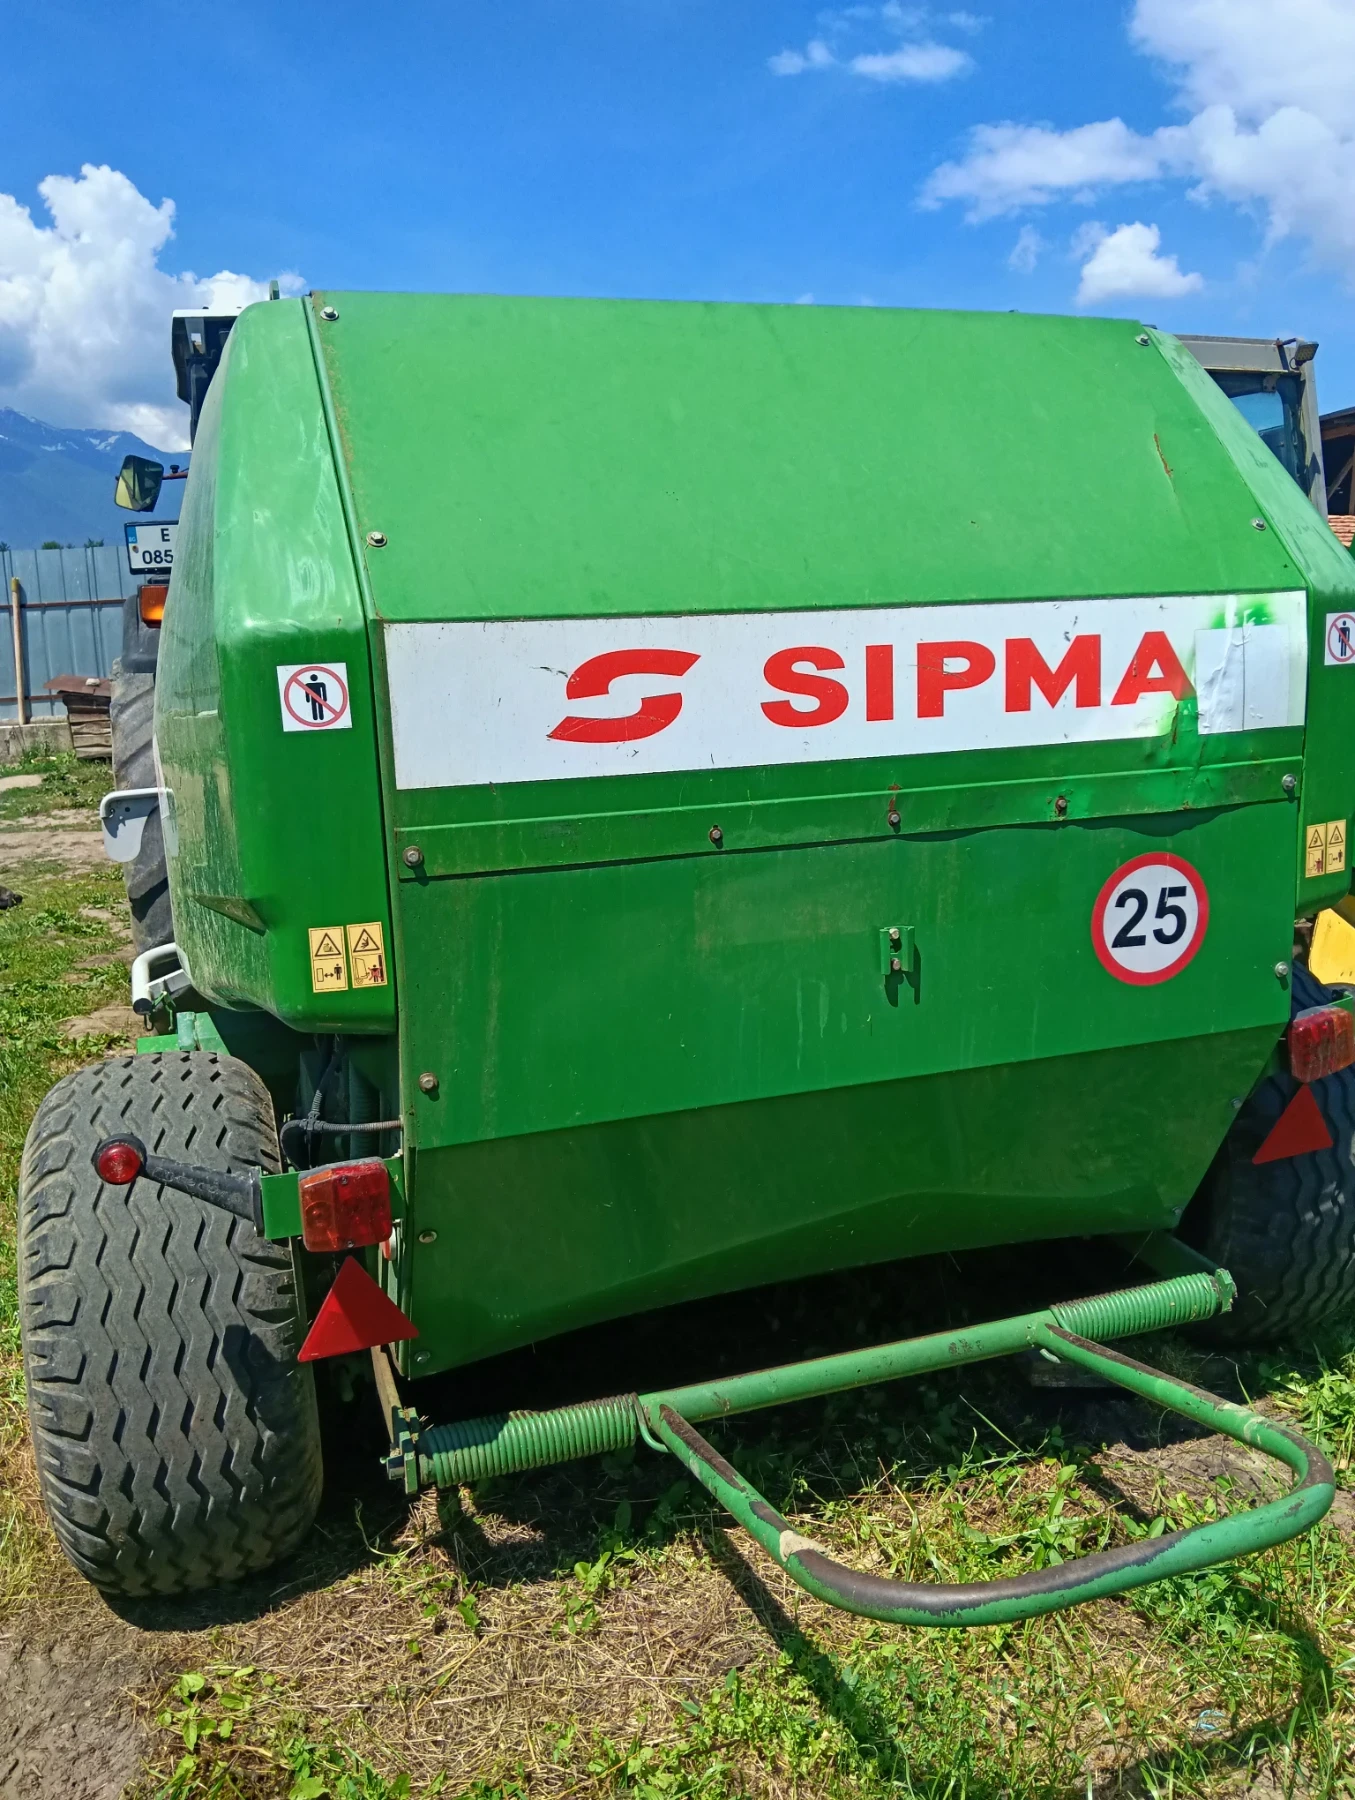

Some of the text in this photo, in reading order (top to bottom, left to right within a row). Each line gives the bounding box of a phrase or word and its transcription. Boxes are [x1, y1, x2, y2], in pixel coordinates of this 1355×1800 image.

[160, 528, 171, 542] E
[760, 631, 1197, 728] SIPMA
[1111, 886, 1188, 949] 25
